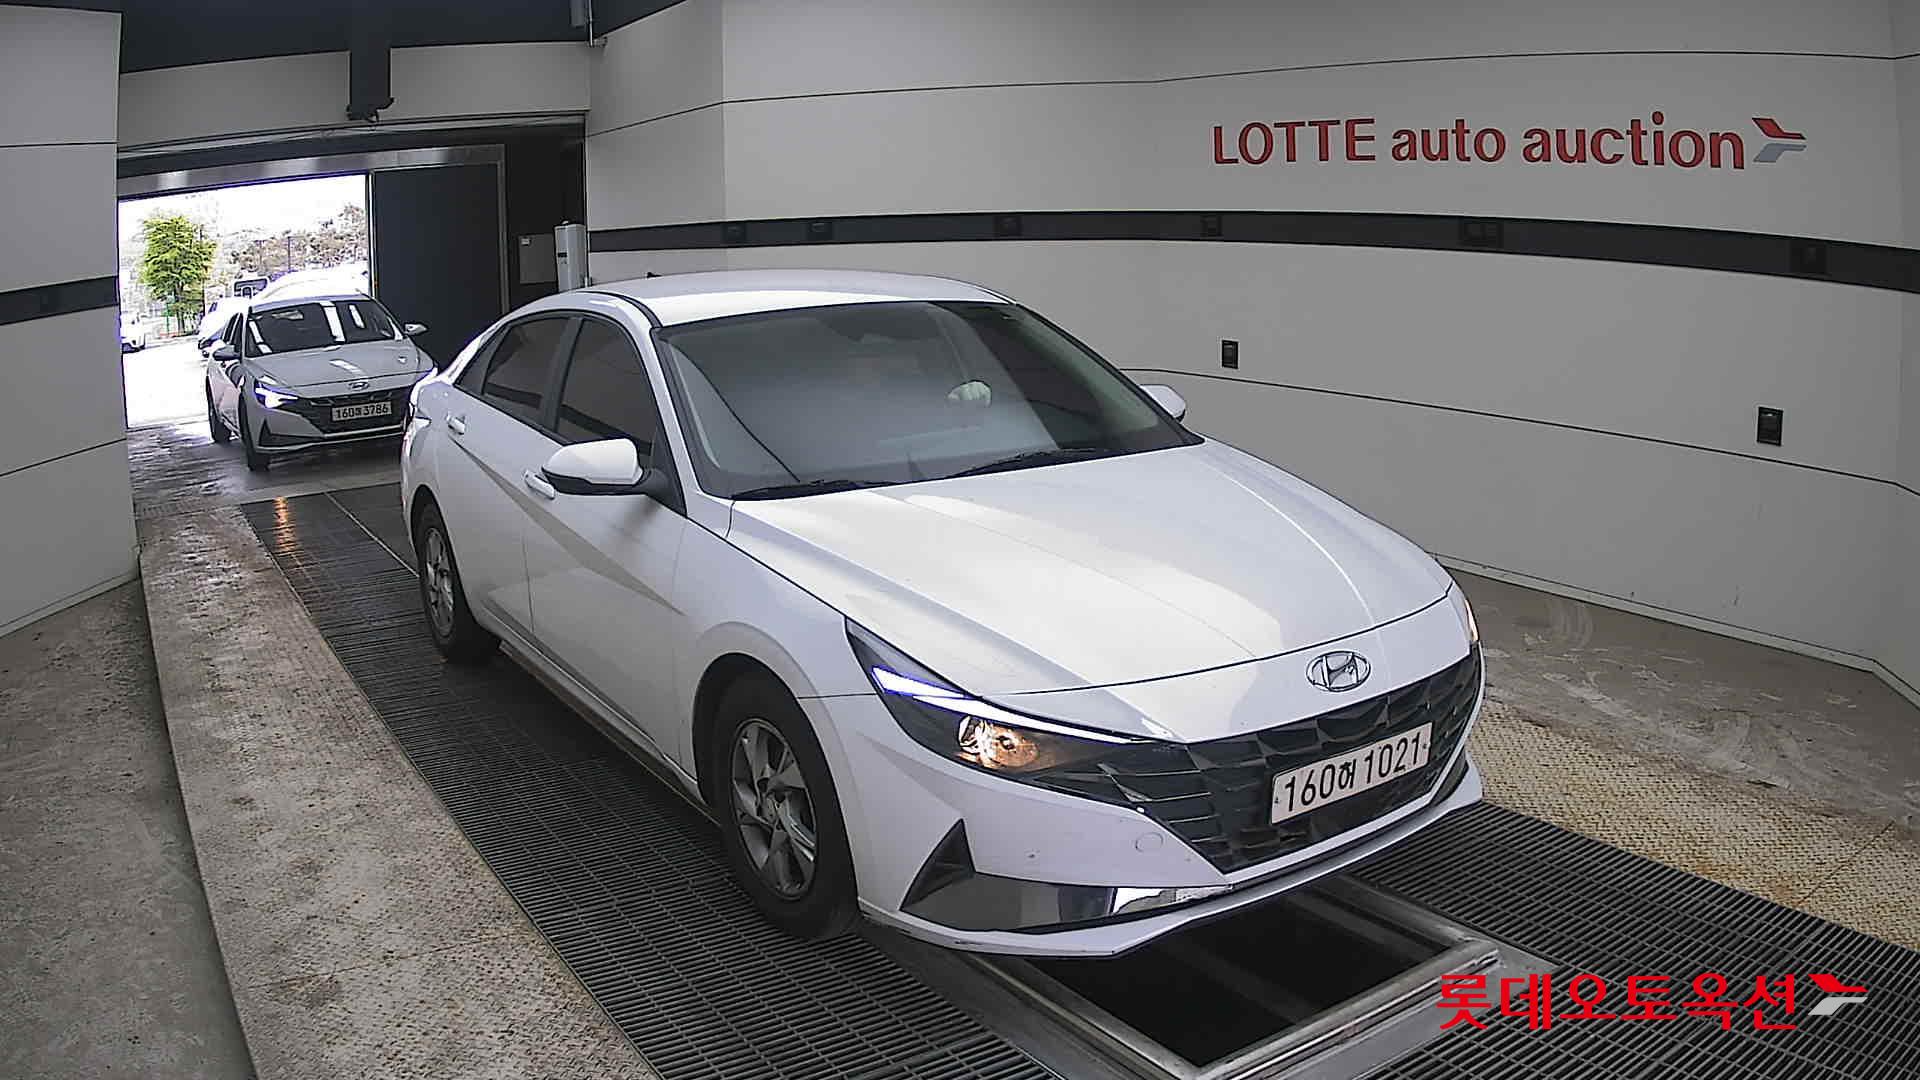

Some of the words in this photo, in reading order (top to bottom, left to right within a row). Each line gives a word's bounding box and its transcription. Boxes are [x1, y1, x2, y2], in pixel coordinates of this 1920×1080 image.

[1213, 119, 1376, 165] LOTTE
[1390, 119, 1507, 164] auto
[1521, 112, 1746, 170] auction
[1364, 731, 1421, 784] 1021
